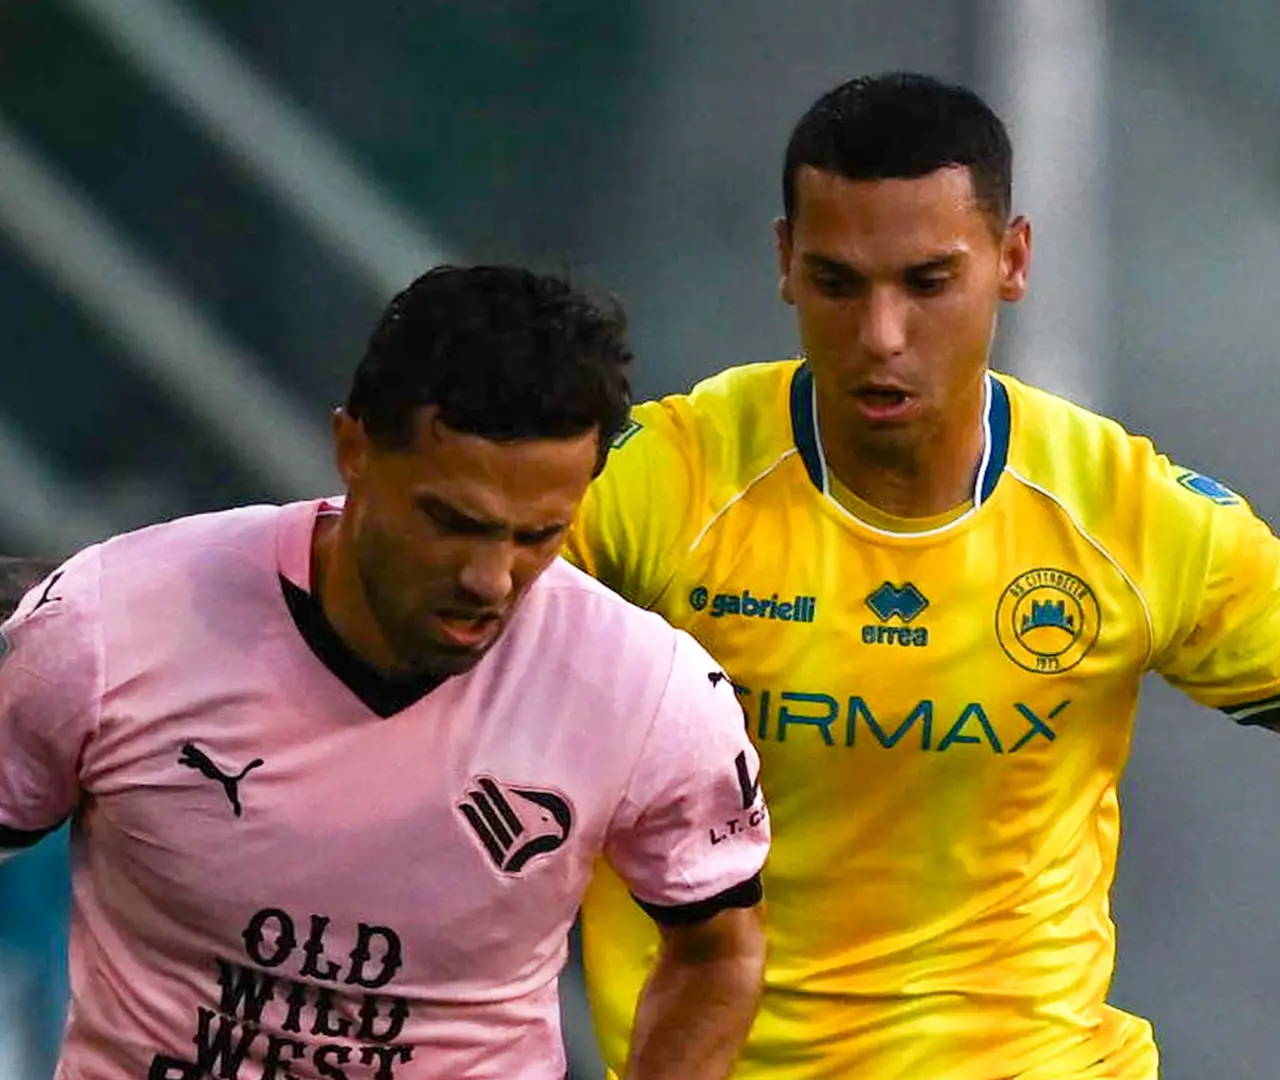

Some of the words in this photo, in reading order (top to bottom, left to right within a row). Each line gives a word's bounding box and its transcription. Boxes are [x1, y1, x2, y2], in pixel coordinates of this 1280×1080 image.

[708, 590, 816, 622] gabrielli
[734, 684, 1072, 755] IRMAX
[242, 907, 402, 988] OLD
[216, 957, 409, 1042] WILD
